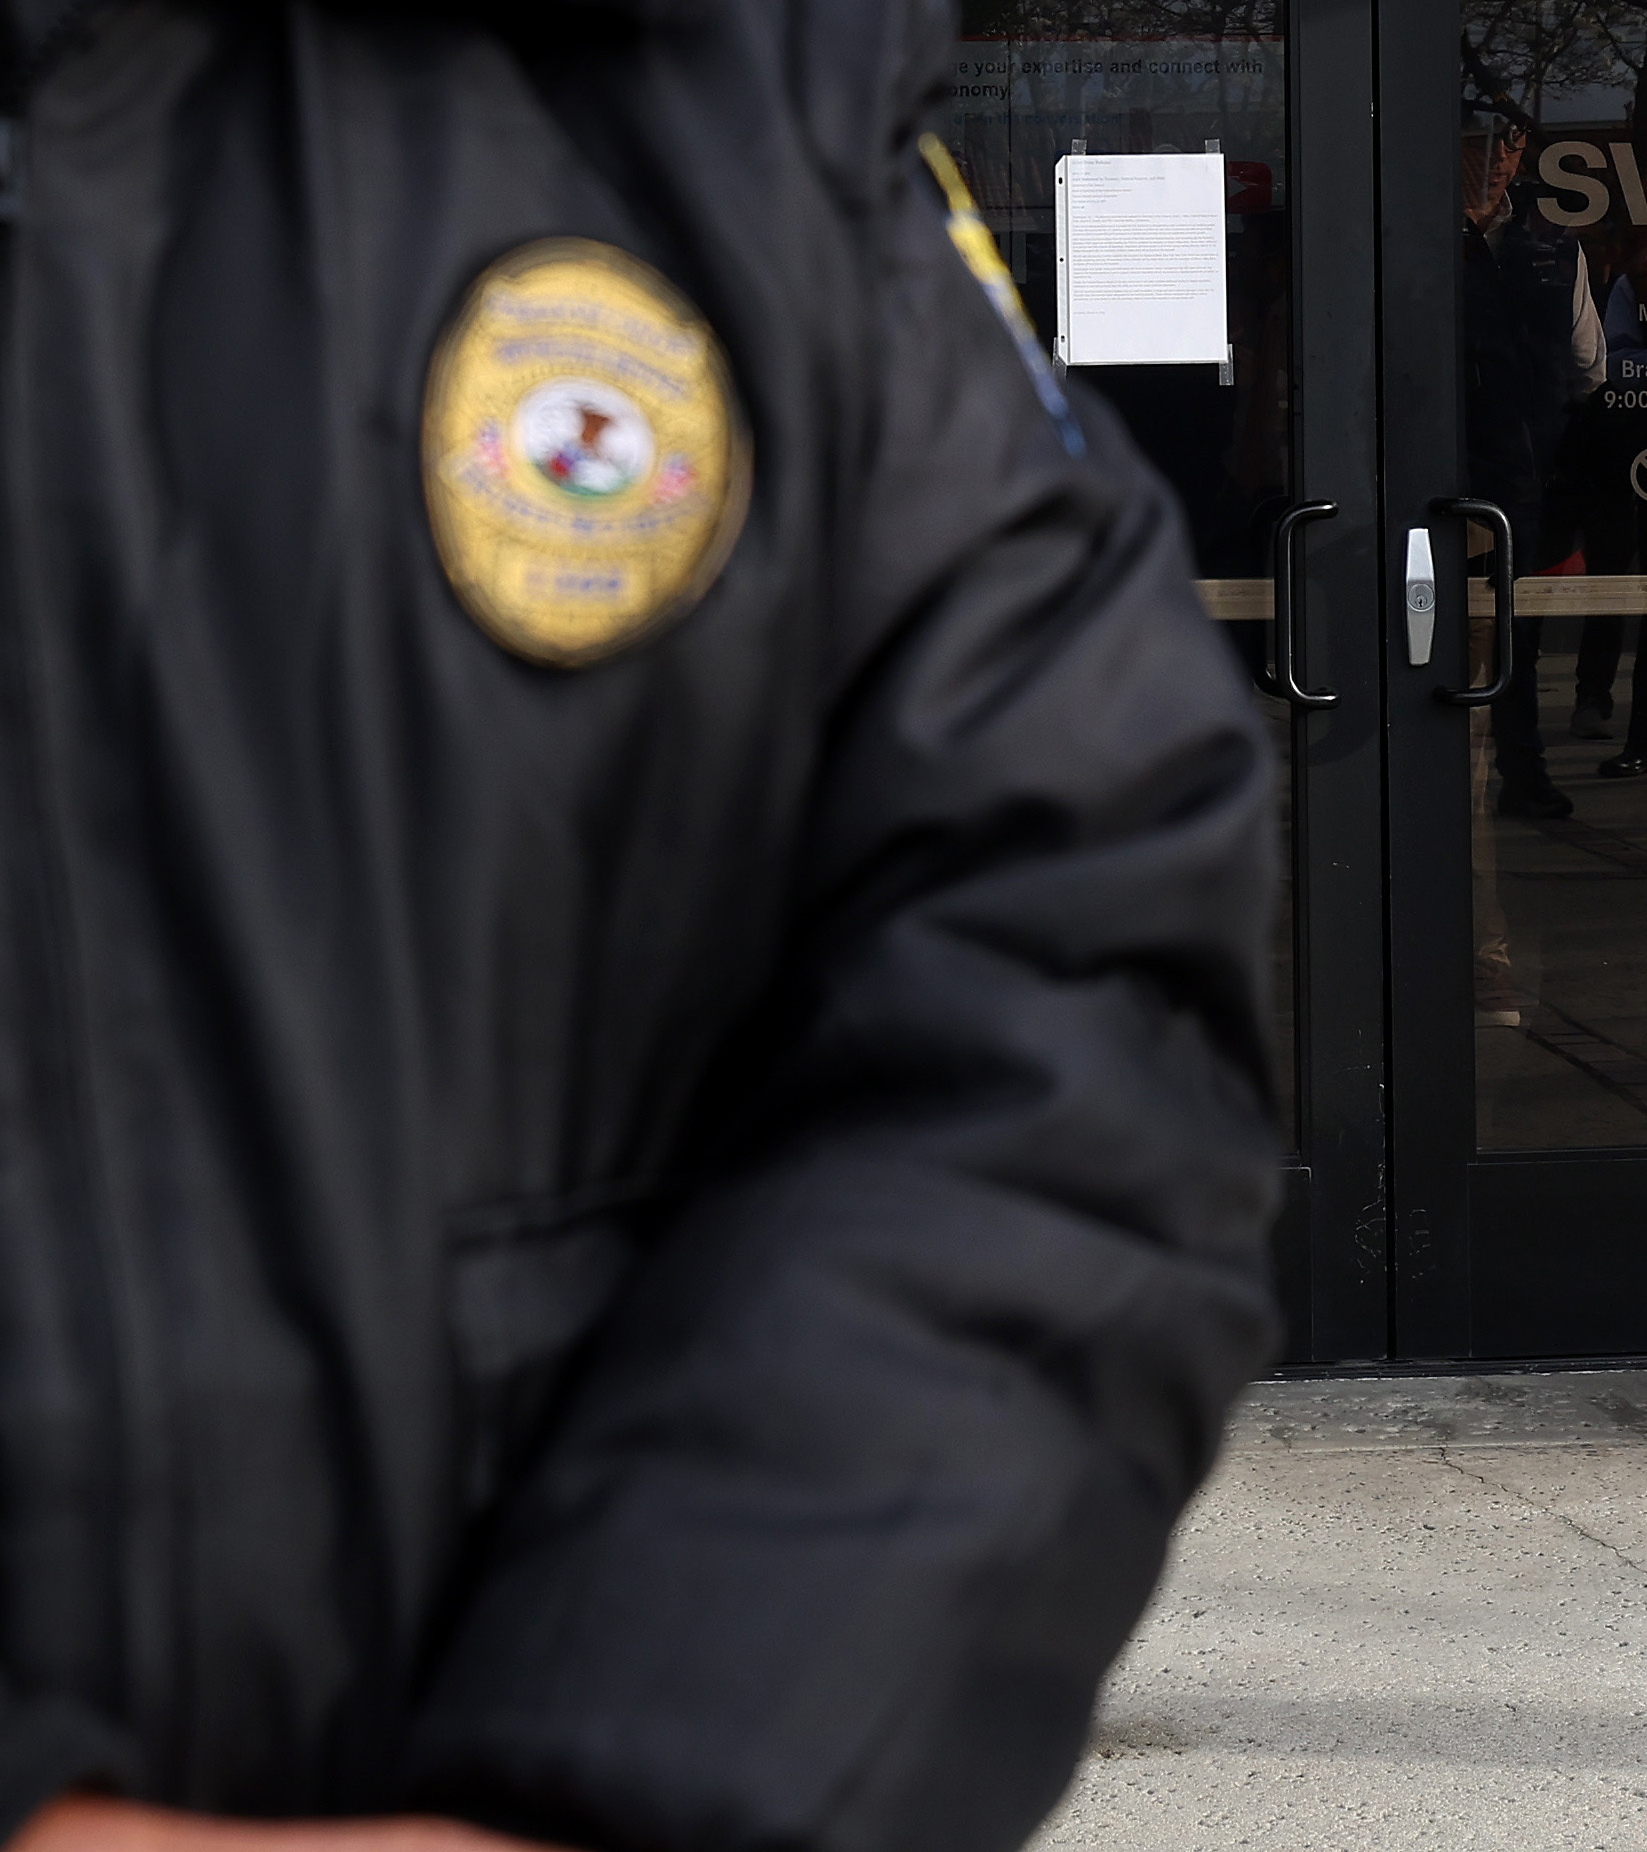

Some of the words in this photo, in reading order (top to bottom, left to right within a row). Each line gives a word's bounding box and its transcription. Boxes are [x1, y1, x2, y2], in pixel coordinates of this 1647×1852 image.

[1109, 58, 1142, 74] and
[1149, 59, 1221, 74] connect
[1225, 58, 1263, 74] with
